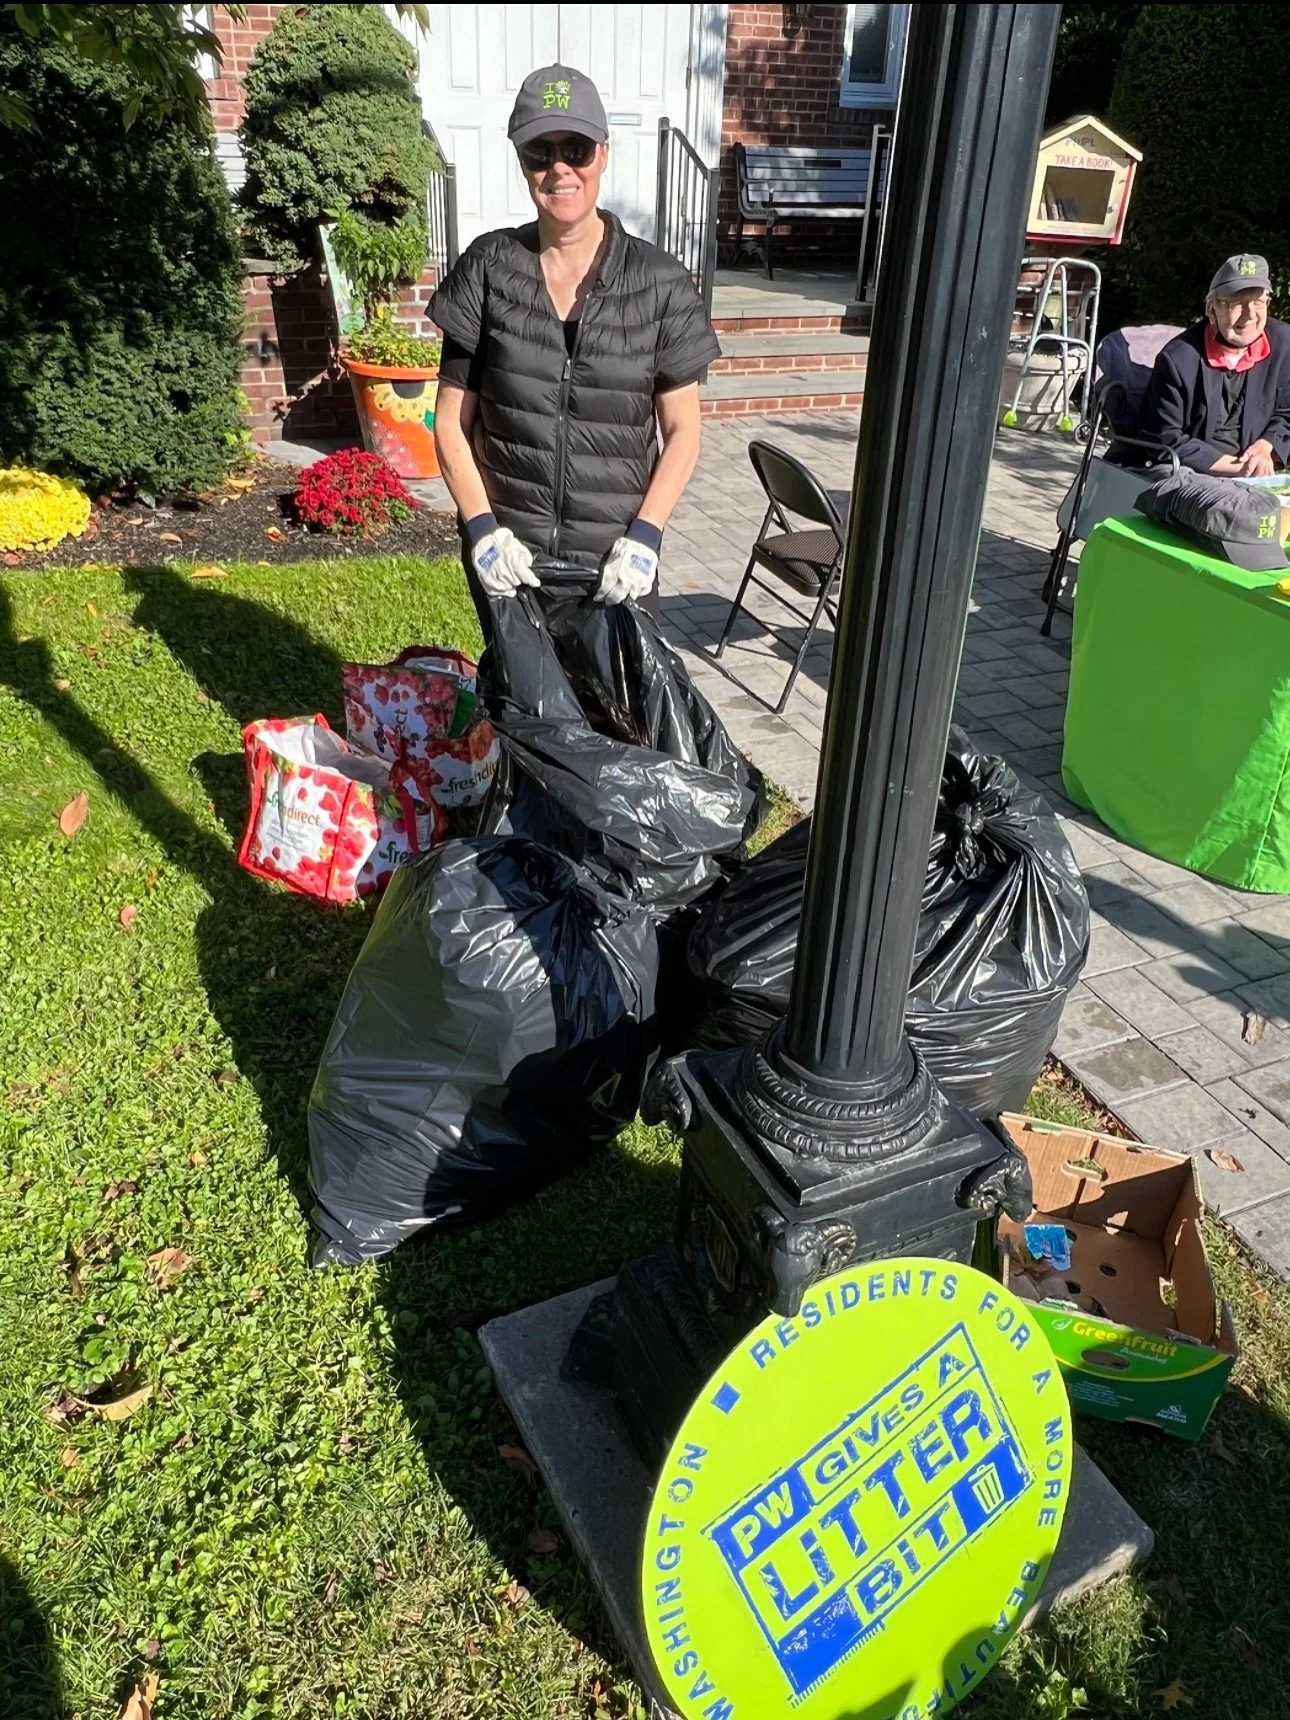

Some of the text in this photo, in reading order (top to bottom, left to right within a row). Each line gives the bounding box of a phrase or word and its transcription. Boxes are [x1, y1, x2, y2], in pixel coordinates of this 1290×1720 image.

[543, 94, 570, 109] PW
[1056, 154, 1077, 166] TAKE
[1257, 527, 1276, 539] PW
[730, 1351, 966, 1559] PW GIVES A
[750, 1270, 1064, 1720] RESIDENTS FOR A MORE BEAUTIFU
[655, 1443, 734, 1720] WASHINGTON
